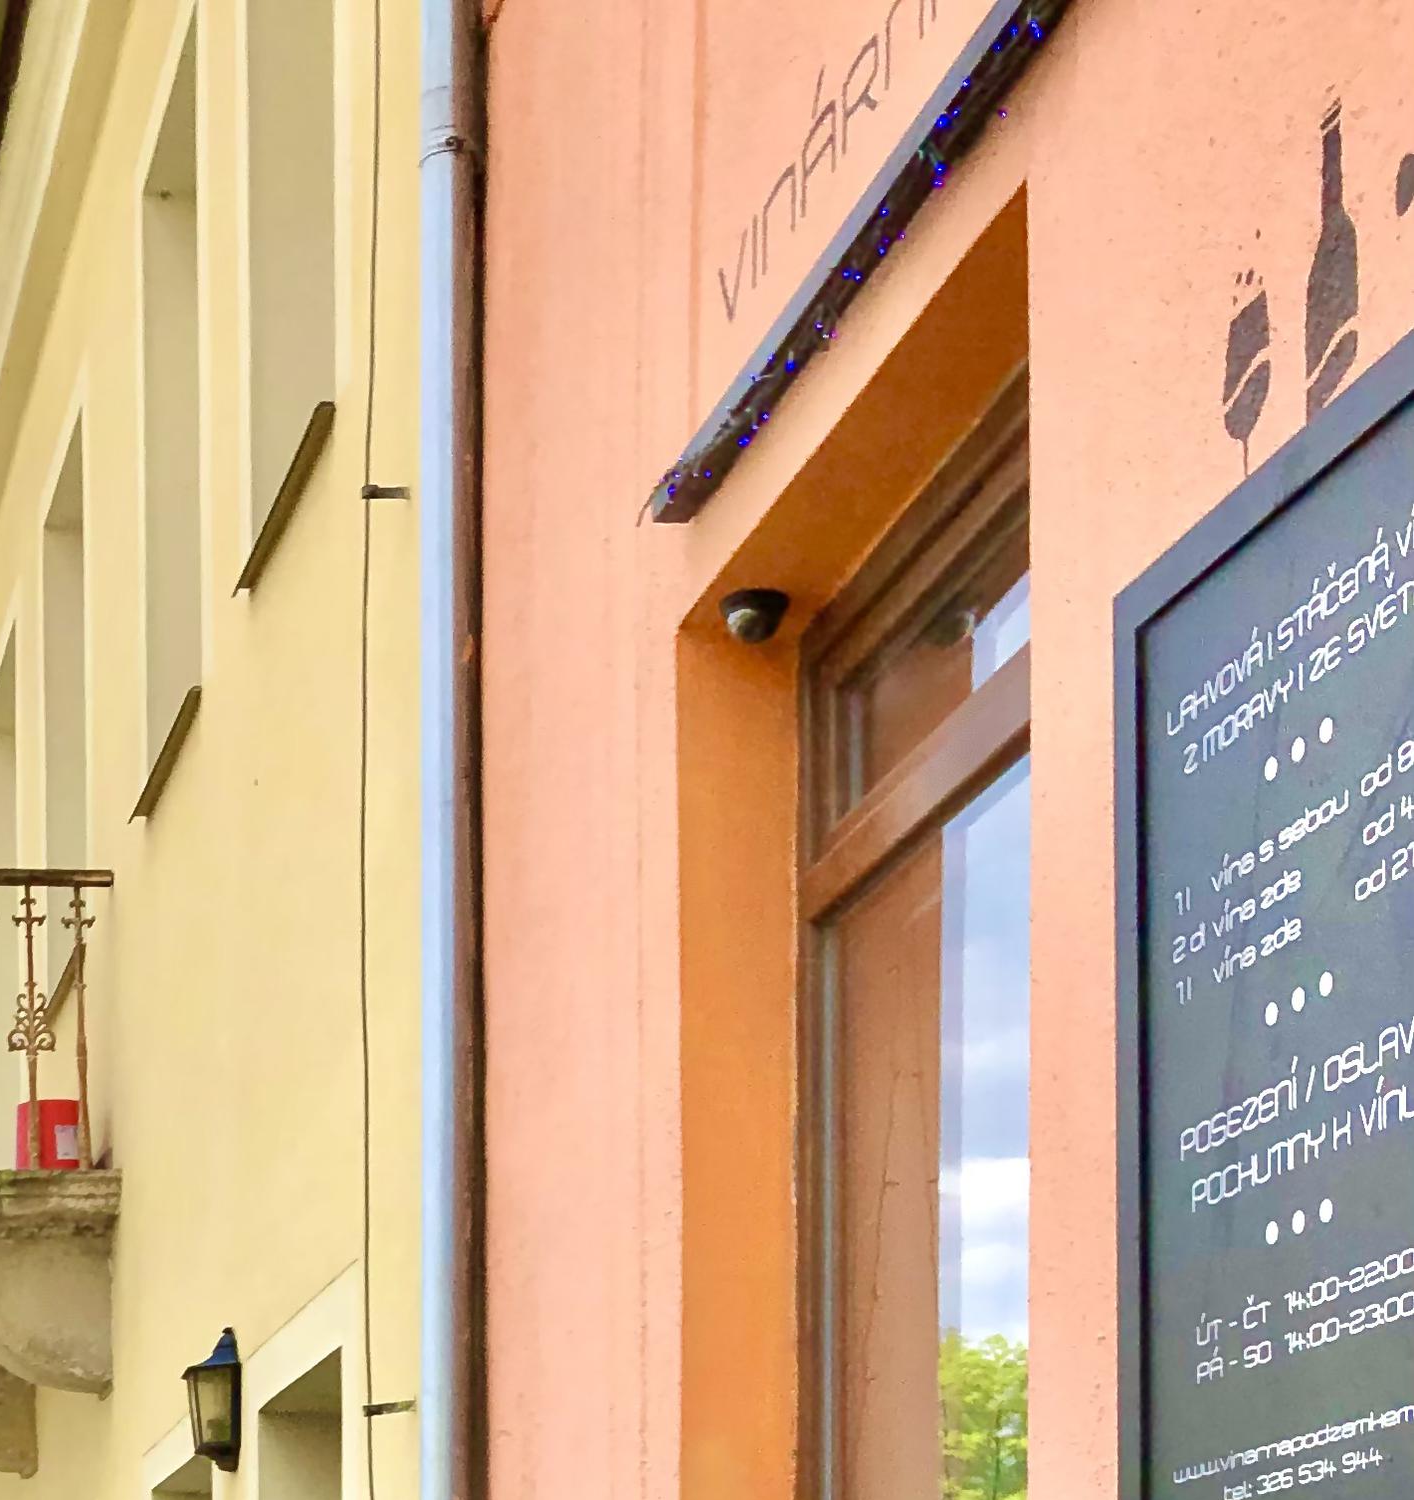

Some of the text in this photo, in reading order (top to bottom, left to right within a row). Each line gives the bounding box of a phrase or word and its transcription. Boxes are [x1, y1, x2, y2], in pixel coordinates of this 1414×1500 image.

[718, 0, 938, 322] VINÁRN
[1277, 527, 1389, 651] STÁČENÁ
[1309, 635, 1342, 683] ZE
[1347, 571, 1414, 653] SVĚT
[1259, 839, 1274, 863] s
[1361, 753, 1392, 797] od
[1362, 803, 1394, 846] od
[1355, 859, 1386, 901] od
[1179, 1055, 1299, 1161] POSEZENÍ
[1196, 1312, 1223, 1346] ÚT
[1243, 1294, 1272, 1330] ČT
[1196, 1346, 1224, 1385] PÁ
[1243, 1340, 1272, 1369] SO
[1256, 1467, 1294, 1495] 326
[1298, 1457, 1337, 1485] 534
[1341, 1447, 1383, 1474] 944
